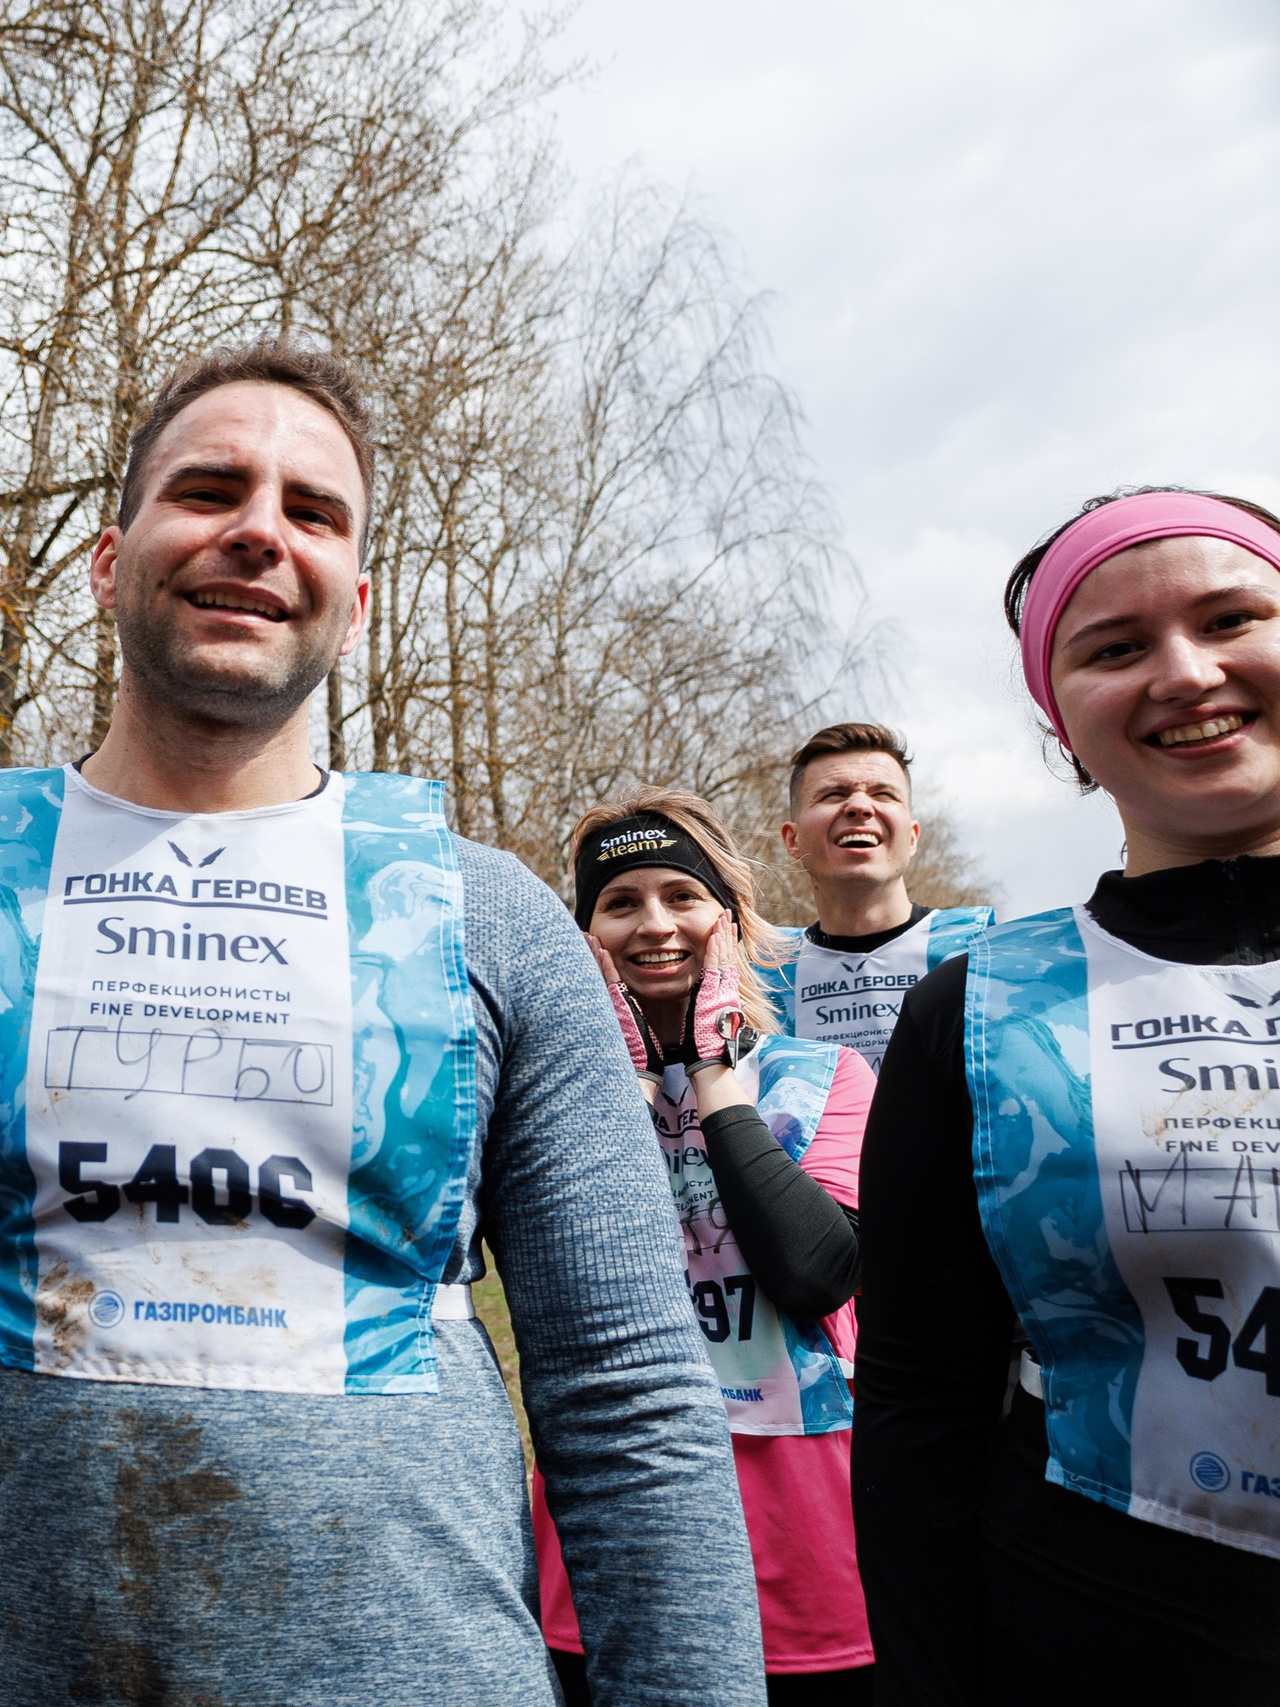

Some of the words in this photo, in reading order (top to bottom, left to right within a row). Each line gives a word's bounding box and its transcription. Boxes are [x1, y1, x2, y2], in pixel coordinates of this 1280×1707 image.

[610, 839, 658, 857] team
[64, 871, 178, 896] ГОНКА
[192, 879, 327, 910] ГЕРОЕВ
[95, 916, 289, 965] Sminex
[92, 980, 291, 1002] ПЕРФЕКЦИОНИСТЫ
[801, 980, 849, 998] ГОНКА
[854, 974, 918, 989] ГЕРОЕВ
[90, 1002, 133, 1016] FINE
[144, 1004, 290, 1024] DEVELOPMENT
[815, 1002, 899, 1025] Sminex
[1111, 1015, 1251, 1041] ГОНКА
[1165, 1140, 1219, 1152] FINE
[58, 1141, 317, 1230] 5406
[133, 1301, 288, 1328] ГАЗПРОМБАНК
